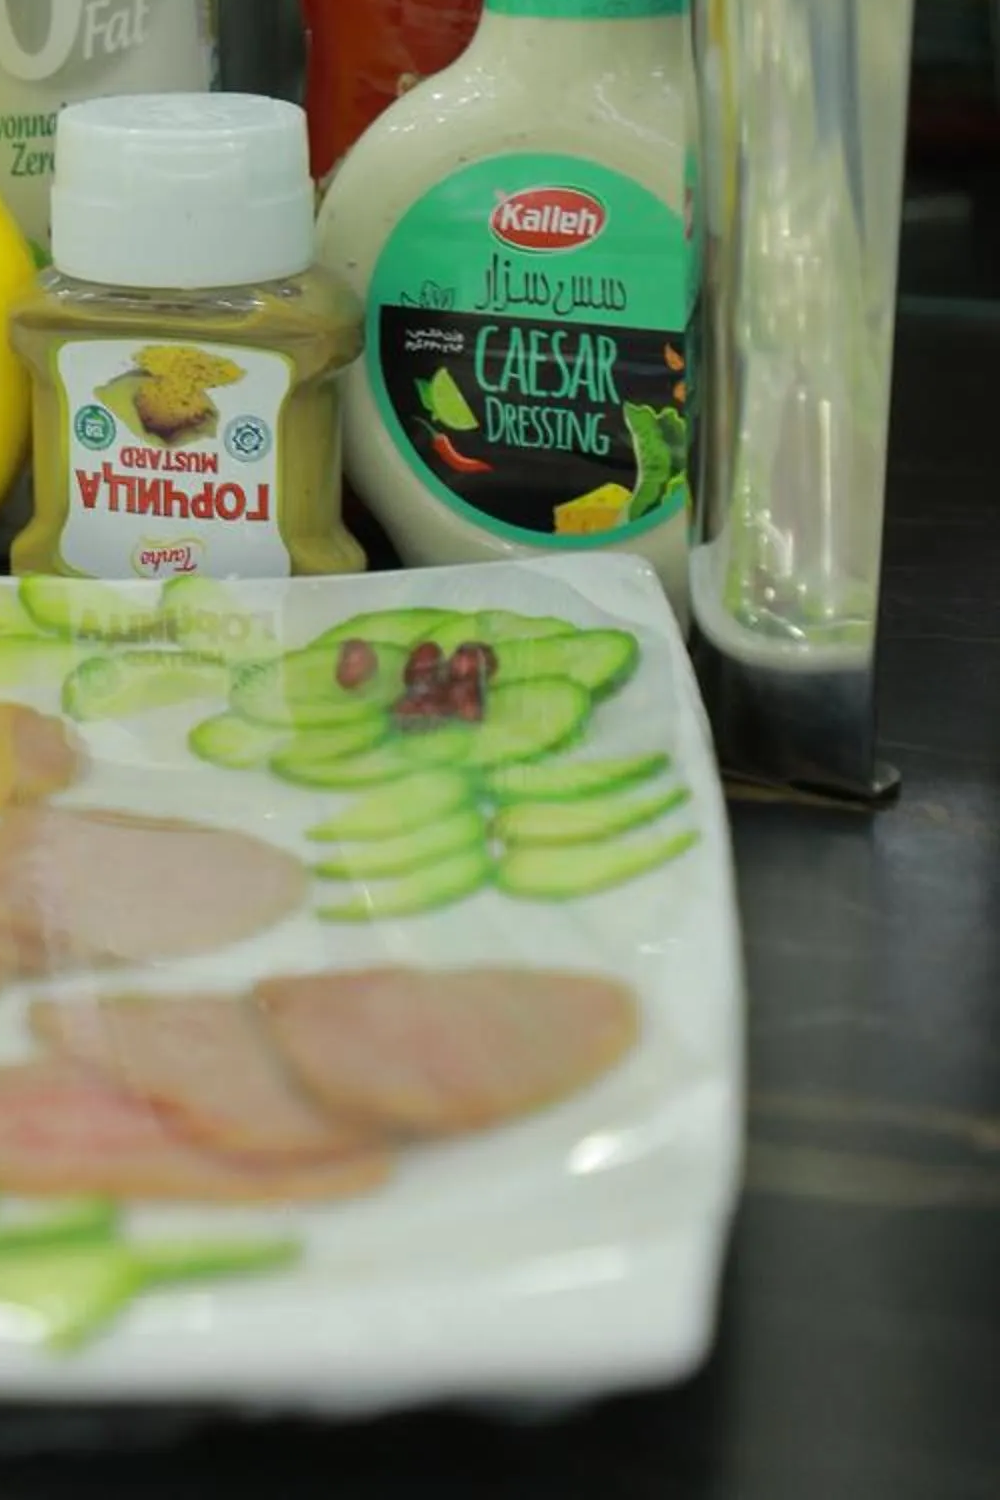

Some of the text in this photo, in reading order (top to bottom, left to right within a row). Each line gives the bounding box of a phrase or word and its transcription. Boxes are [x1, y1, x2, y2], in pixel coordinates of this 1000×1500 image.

[499, 202, 597, 236] Kalleh
[554, 270, 627, 315] سس
[474, 324, 620, 405] CAESAR
[484, 396, 610, 455] DRESSING
[119, 446, 219, 474] MUSTARD
[75, 461, 270, 521] ГОРЧИЦА
